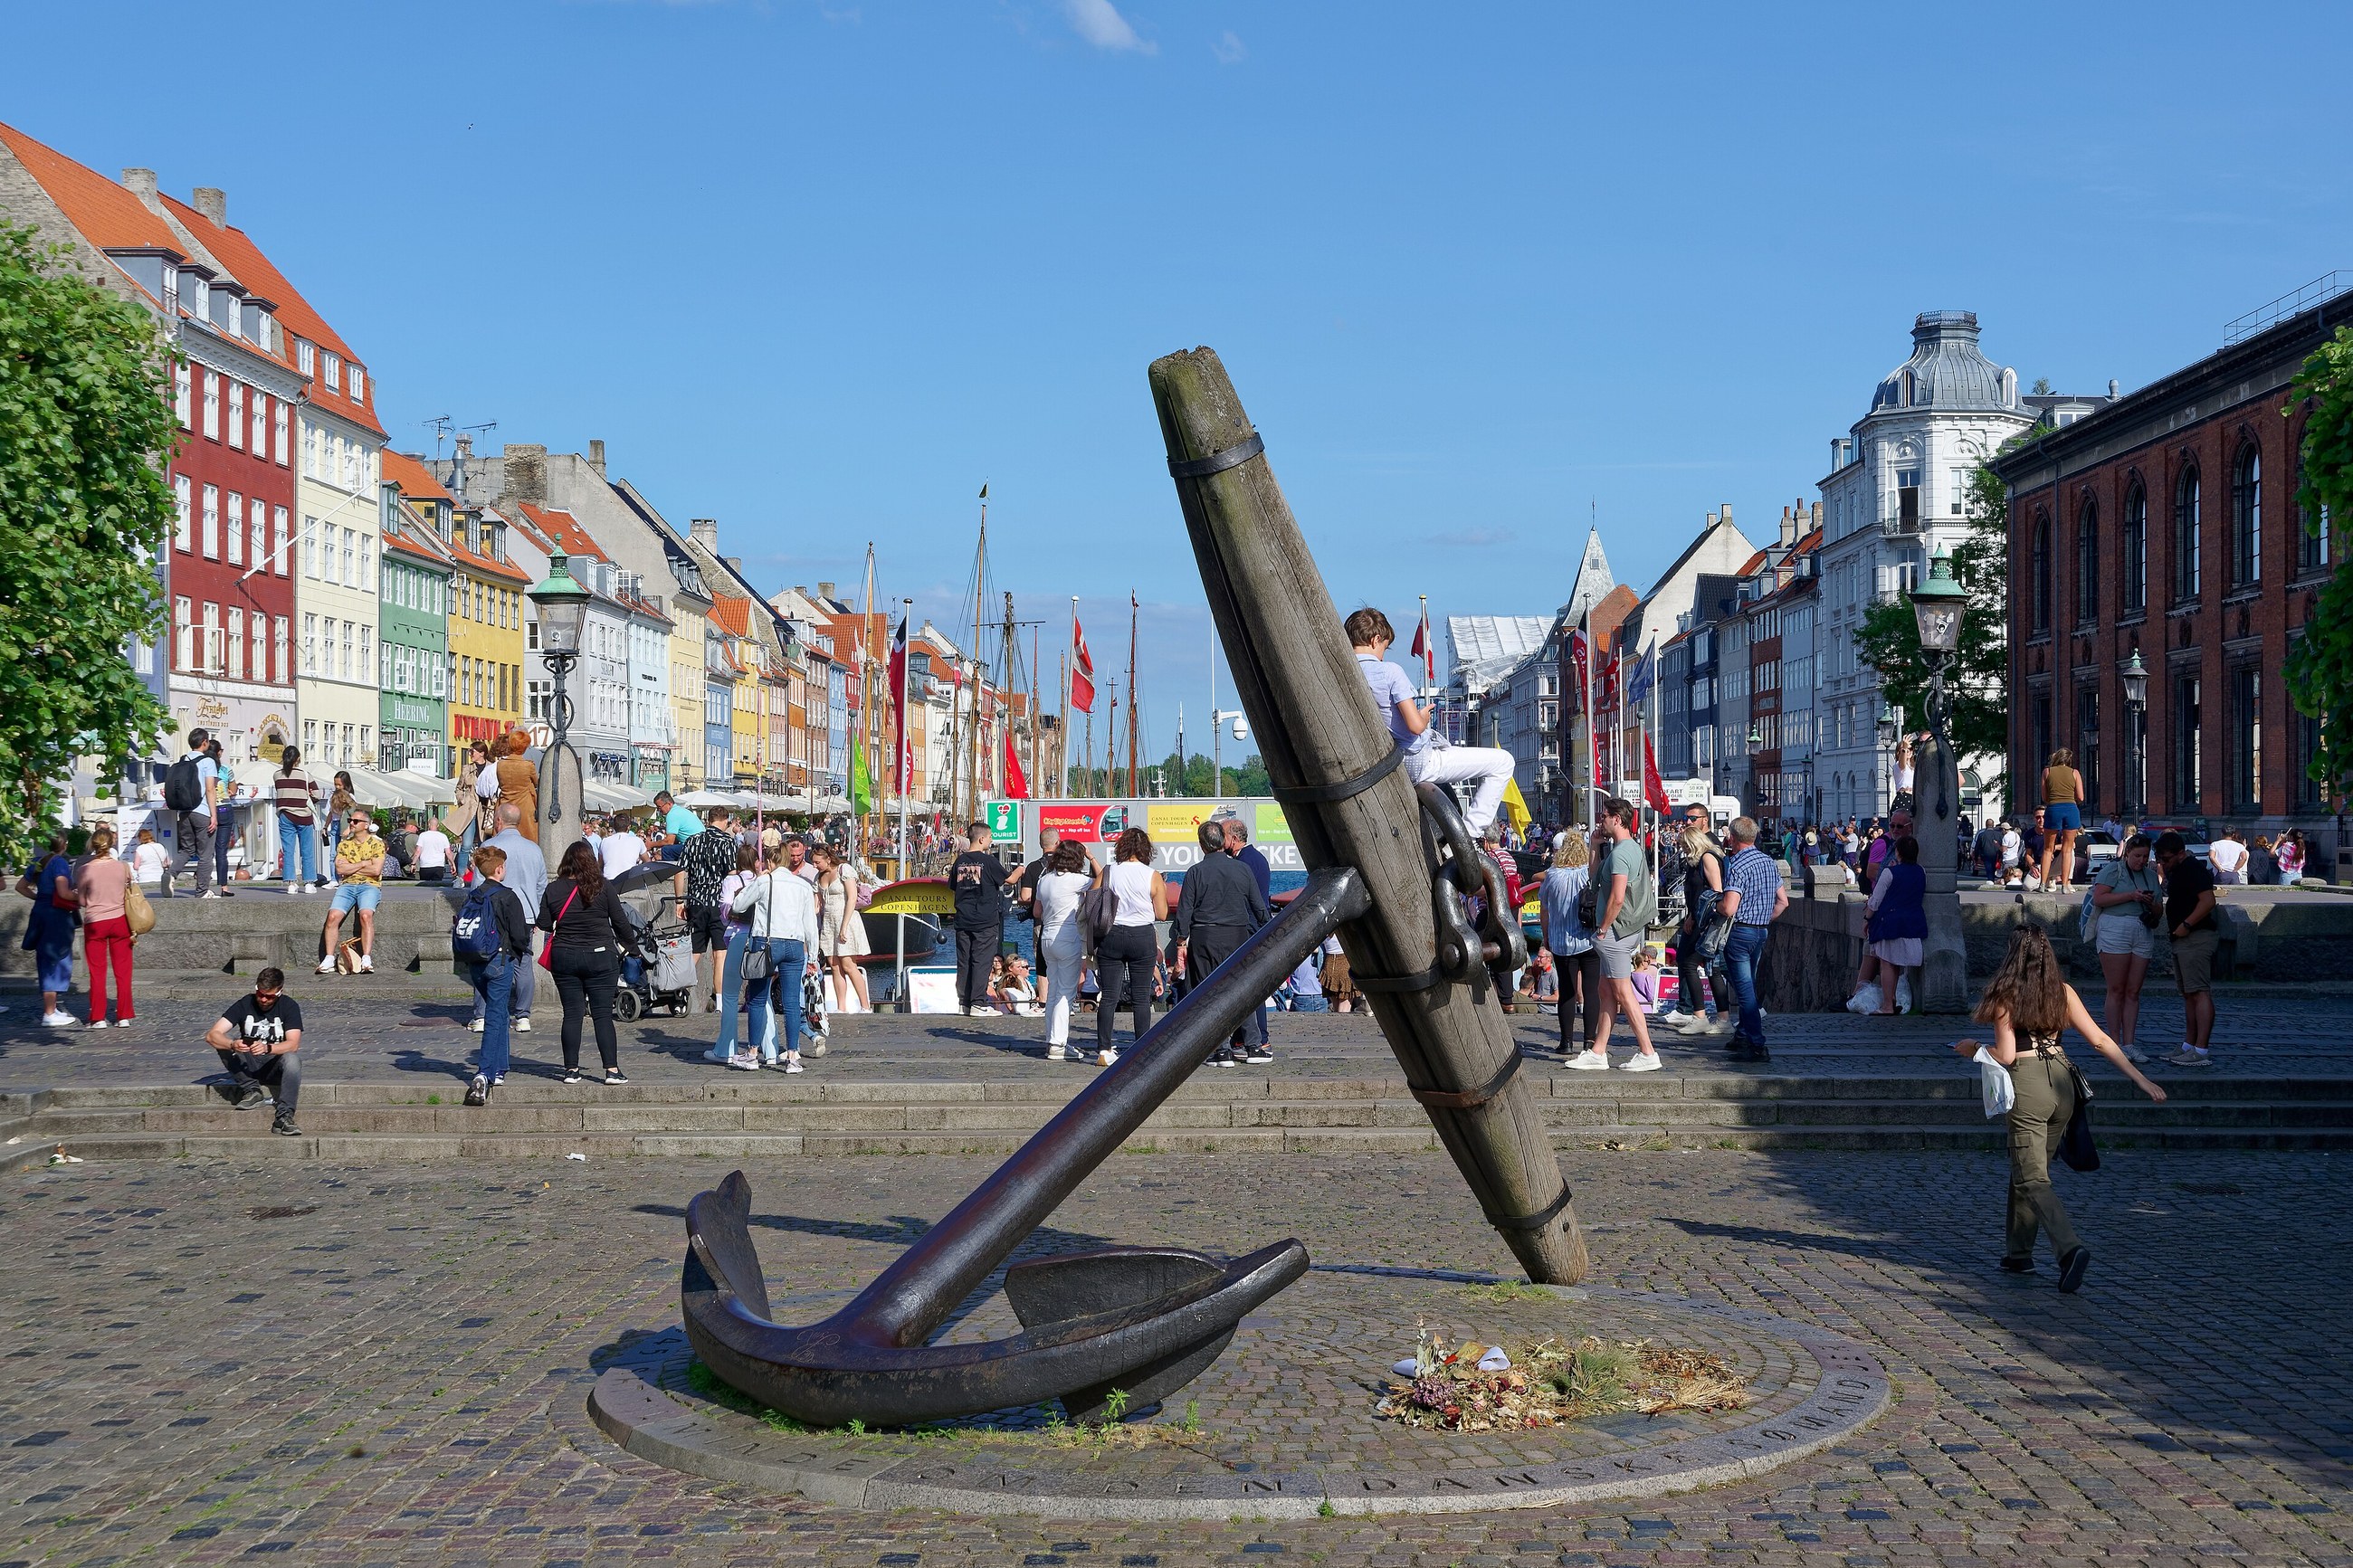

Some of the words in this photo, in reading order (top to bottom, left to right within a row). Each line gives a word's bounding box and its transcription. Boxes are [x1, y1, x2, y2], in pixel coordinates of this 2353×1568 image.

[395, 700, 430, 724] HEERING
[454, 714, 501, 742] NYHAVN
[530, 726, 550, 747] 17
[1159, 845, 1202, 866] YOU
[917, 895, 947, 903] TOURS
[456, 917, 481, 936] EF
[662, 1421, 870, 1472] MINDE
[1361, 1449, 1702, 1491] DANSKE
